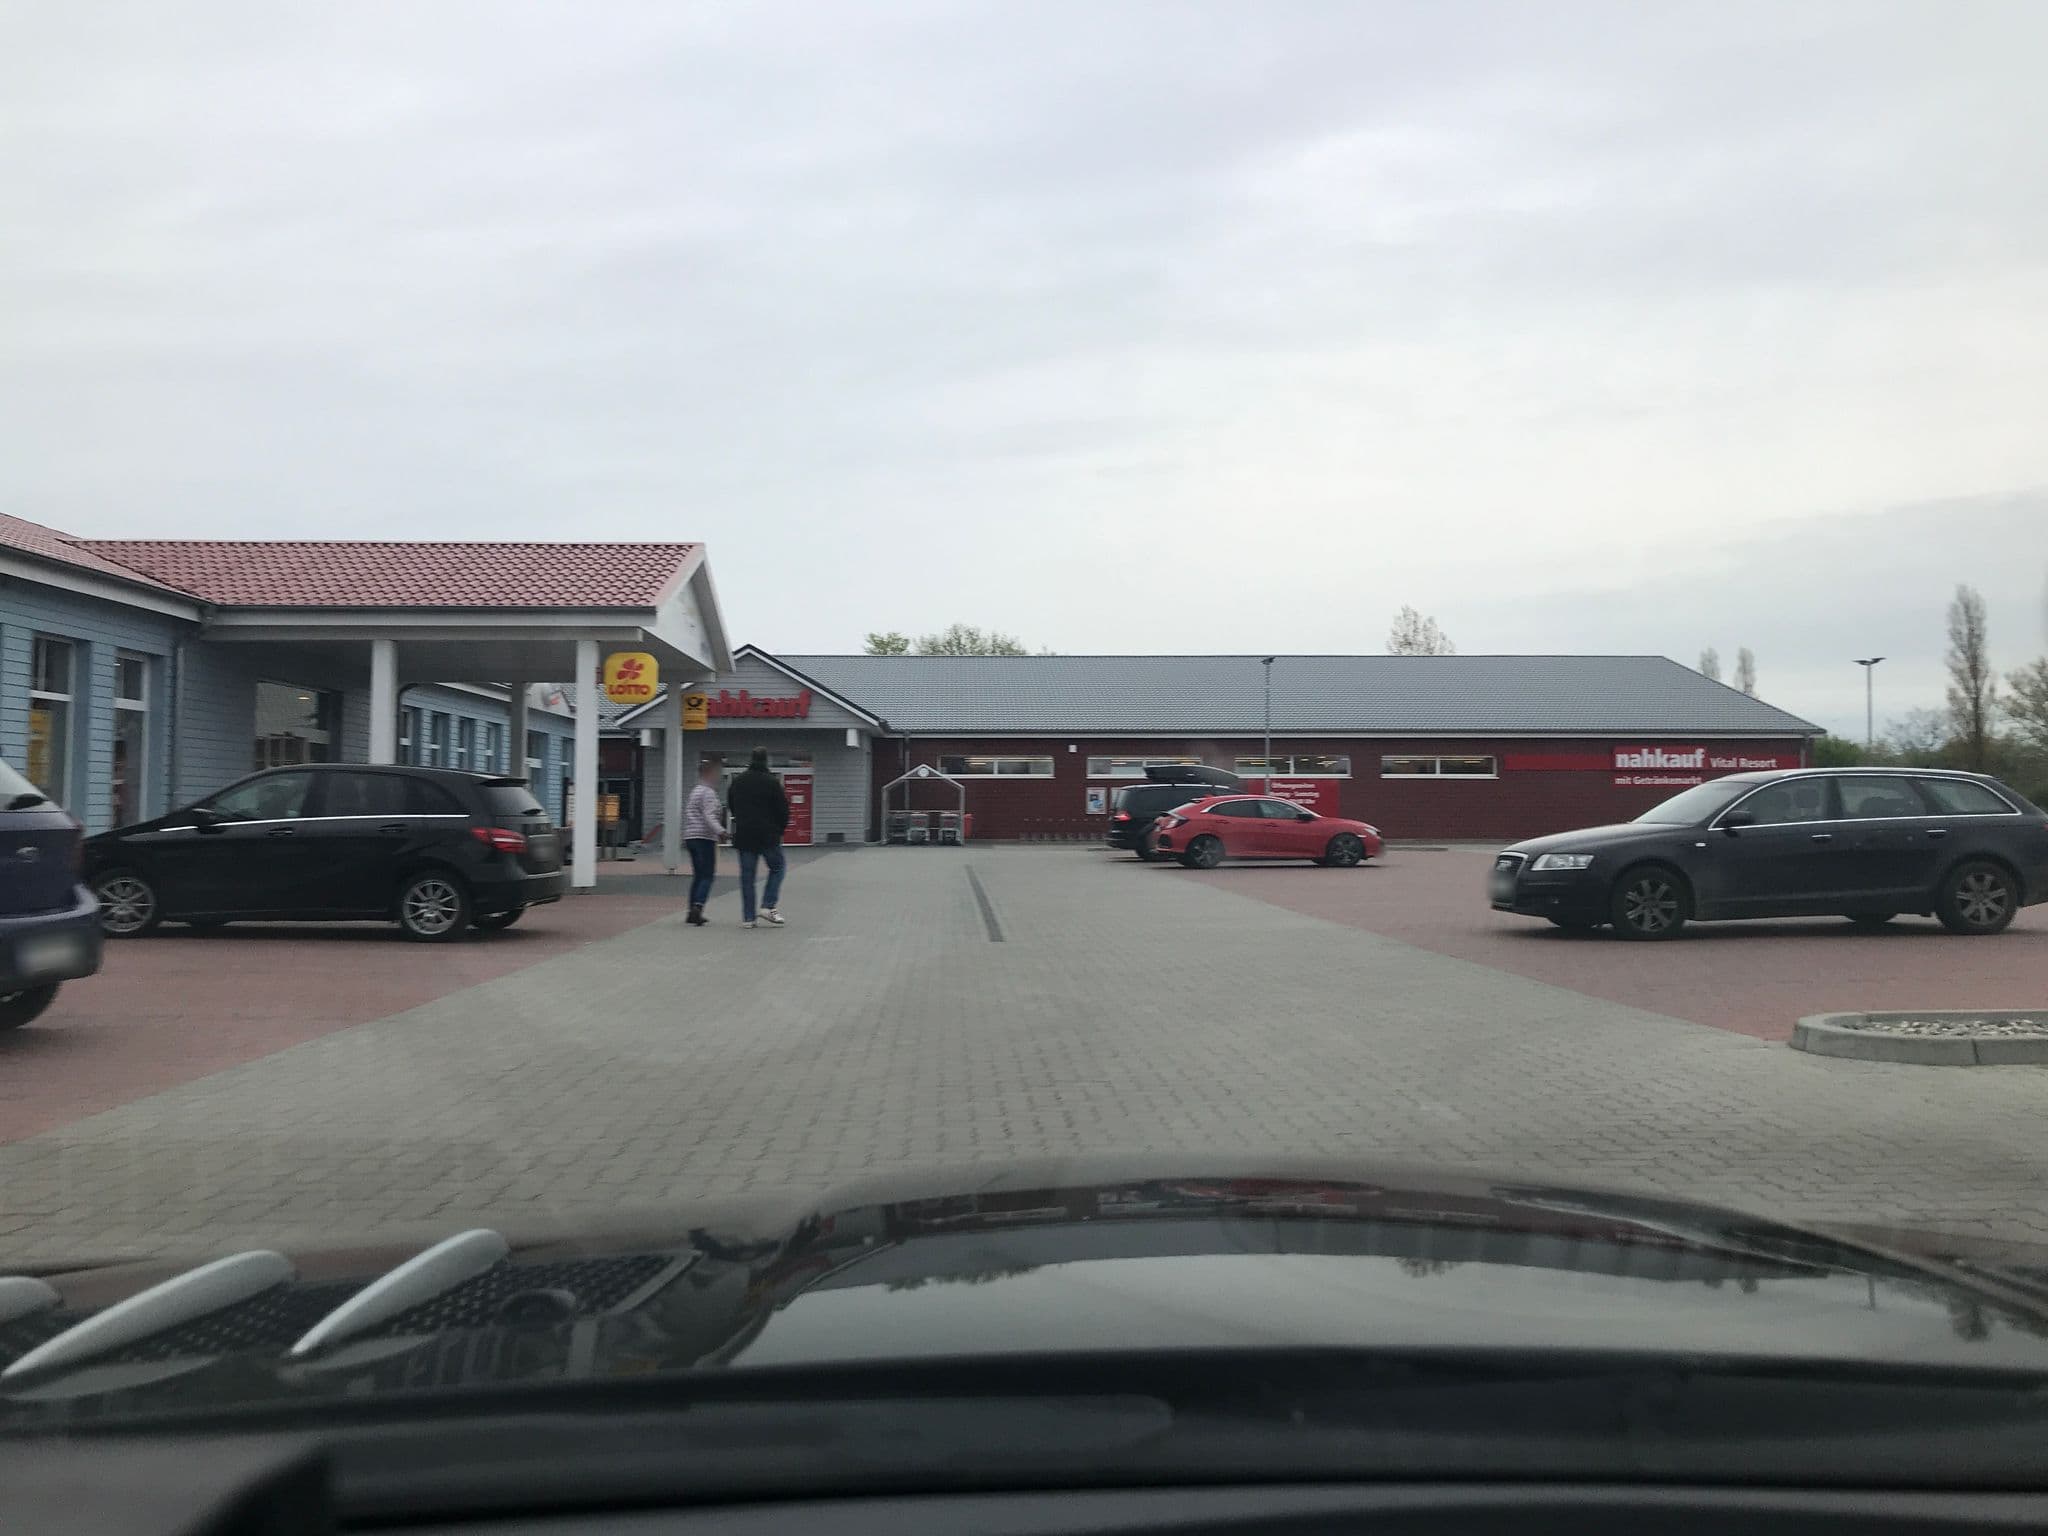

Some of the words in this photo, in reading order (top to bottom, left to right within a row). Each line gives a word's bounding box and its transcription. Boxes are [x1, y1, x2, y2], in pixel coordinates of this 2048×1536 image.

[608, 685, 651, 695] LOTTO
[707, 689, 812, 718] ahkauf
[1615, 748, 1705, 768] nahkauf
[1710, 757, 1737, 768] Vital
[1739, 758, 1777, 768] Resort
[1615, 776, 1631, 785] mit
[1633, 776, 1702, 785] Getränkemarkt
